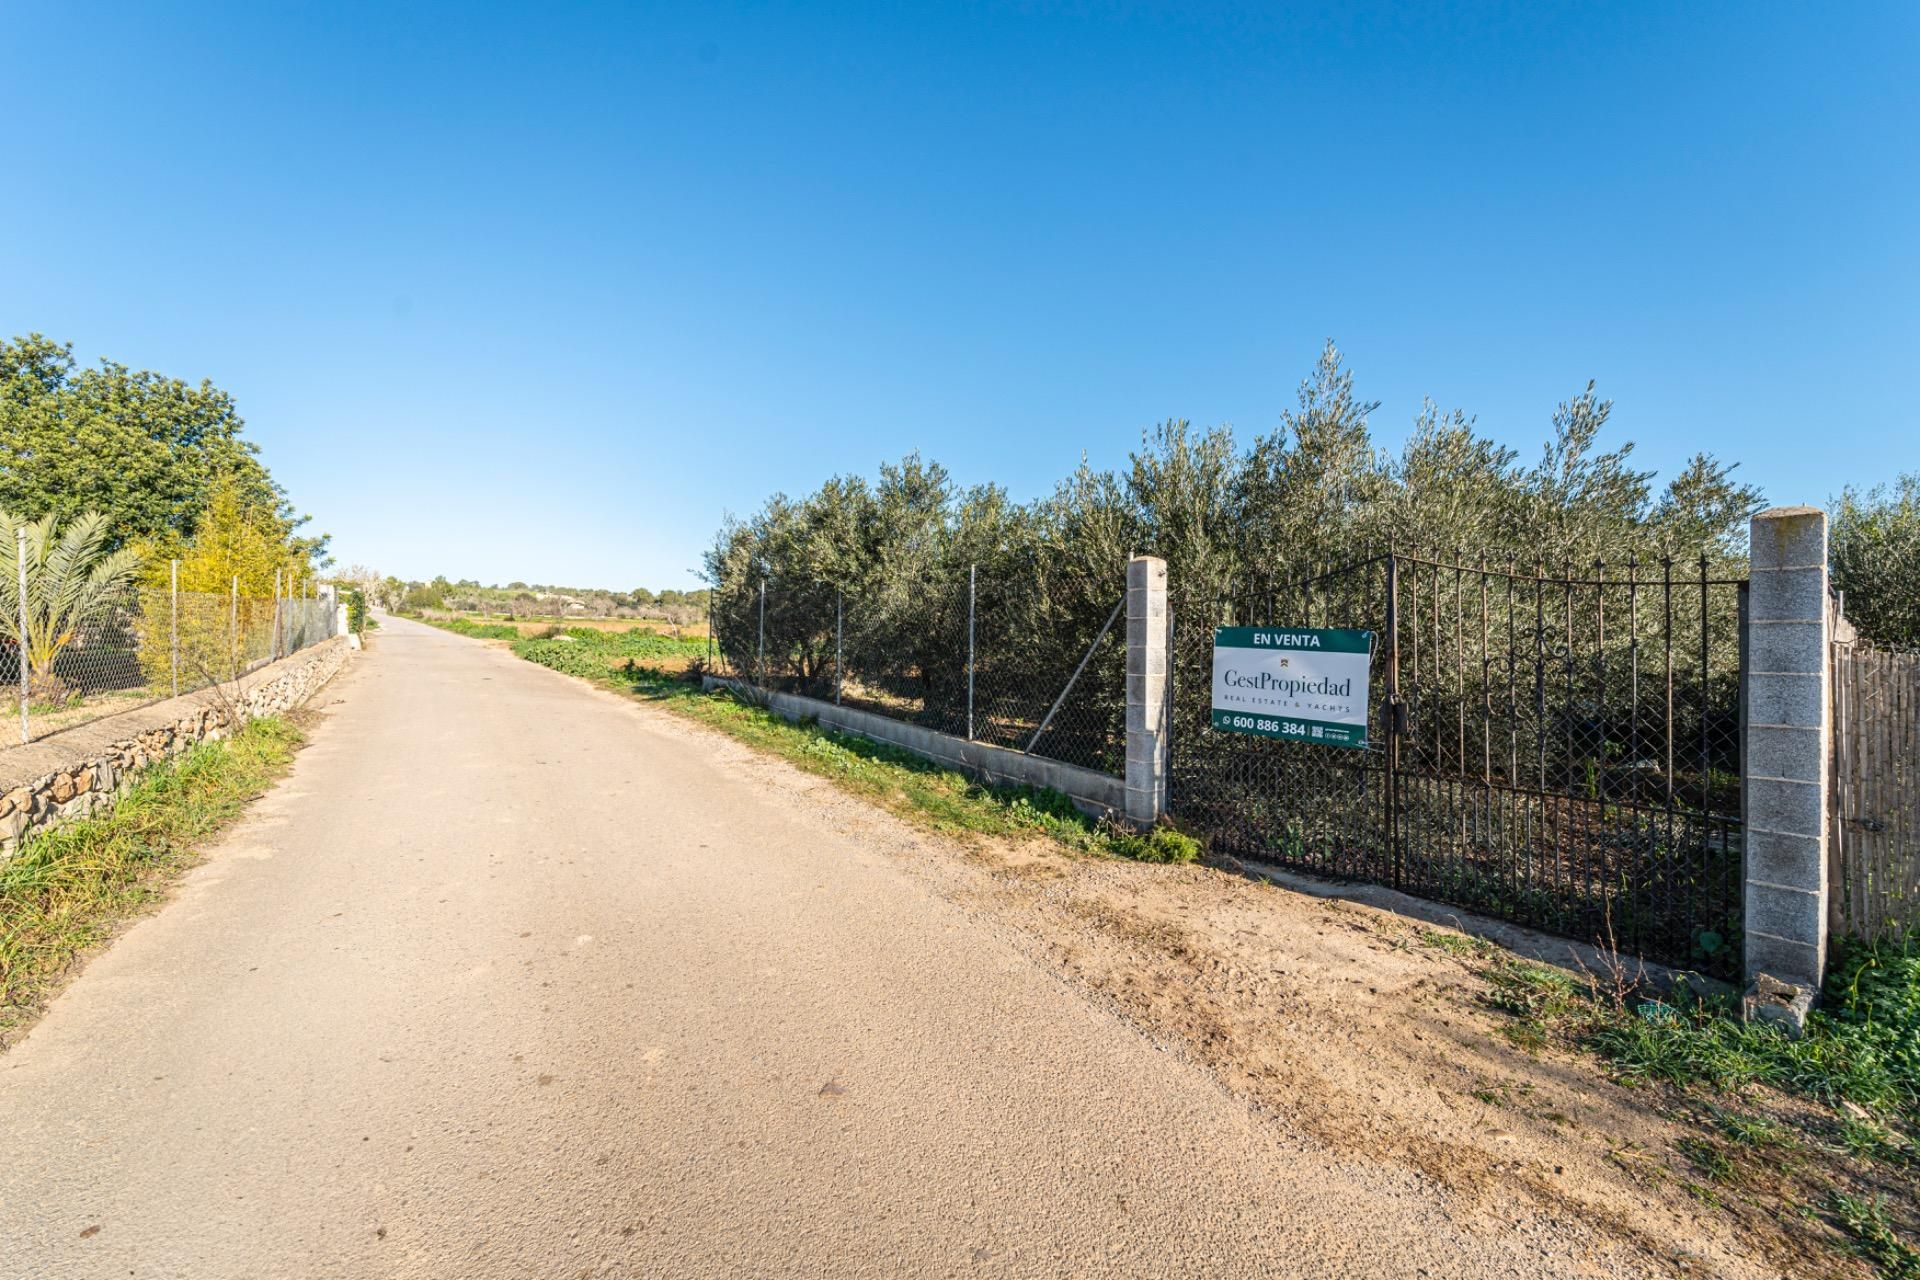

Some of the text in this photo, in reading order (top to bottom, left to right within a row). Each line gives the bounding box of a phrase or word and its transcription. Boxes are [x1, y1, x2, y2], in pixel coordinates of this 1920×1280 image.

[1253, 633, 1321, 647] EN VENTA
[1224, 669, 1351, 697] GestPropiedad
[1224, 694, 1246, 703] REAL
[1251, 697, 1288, 707] ESTATE
[1307, 703, 1350, 713] YACHTS
[1233, 716, 1306, 736] 600 886 384
